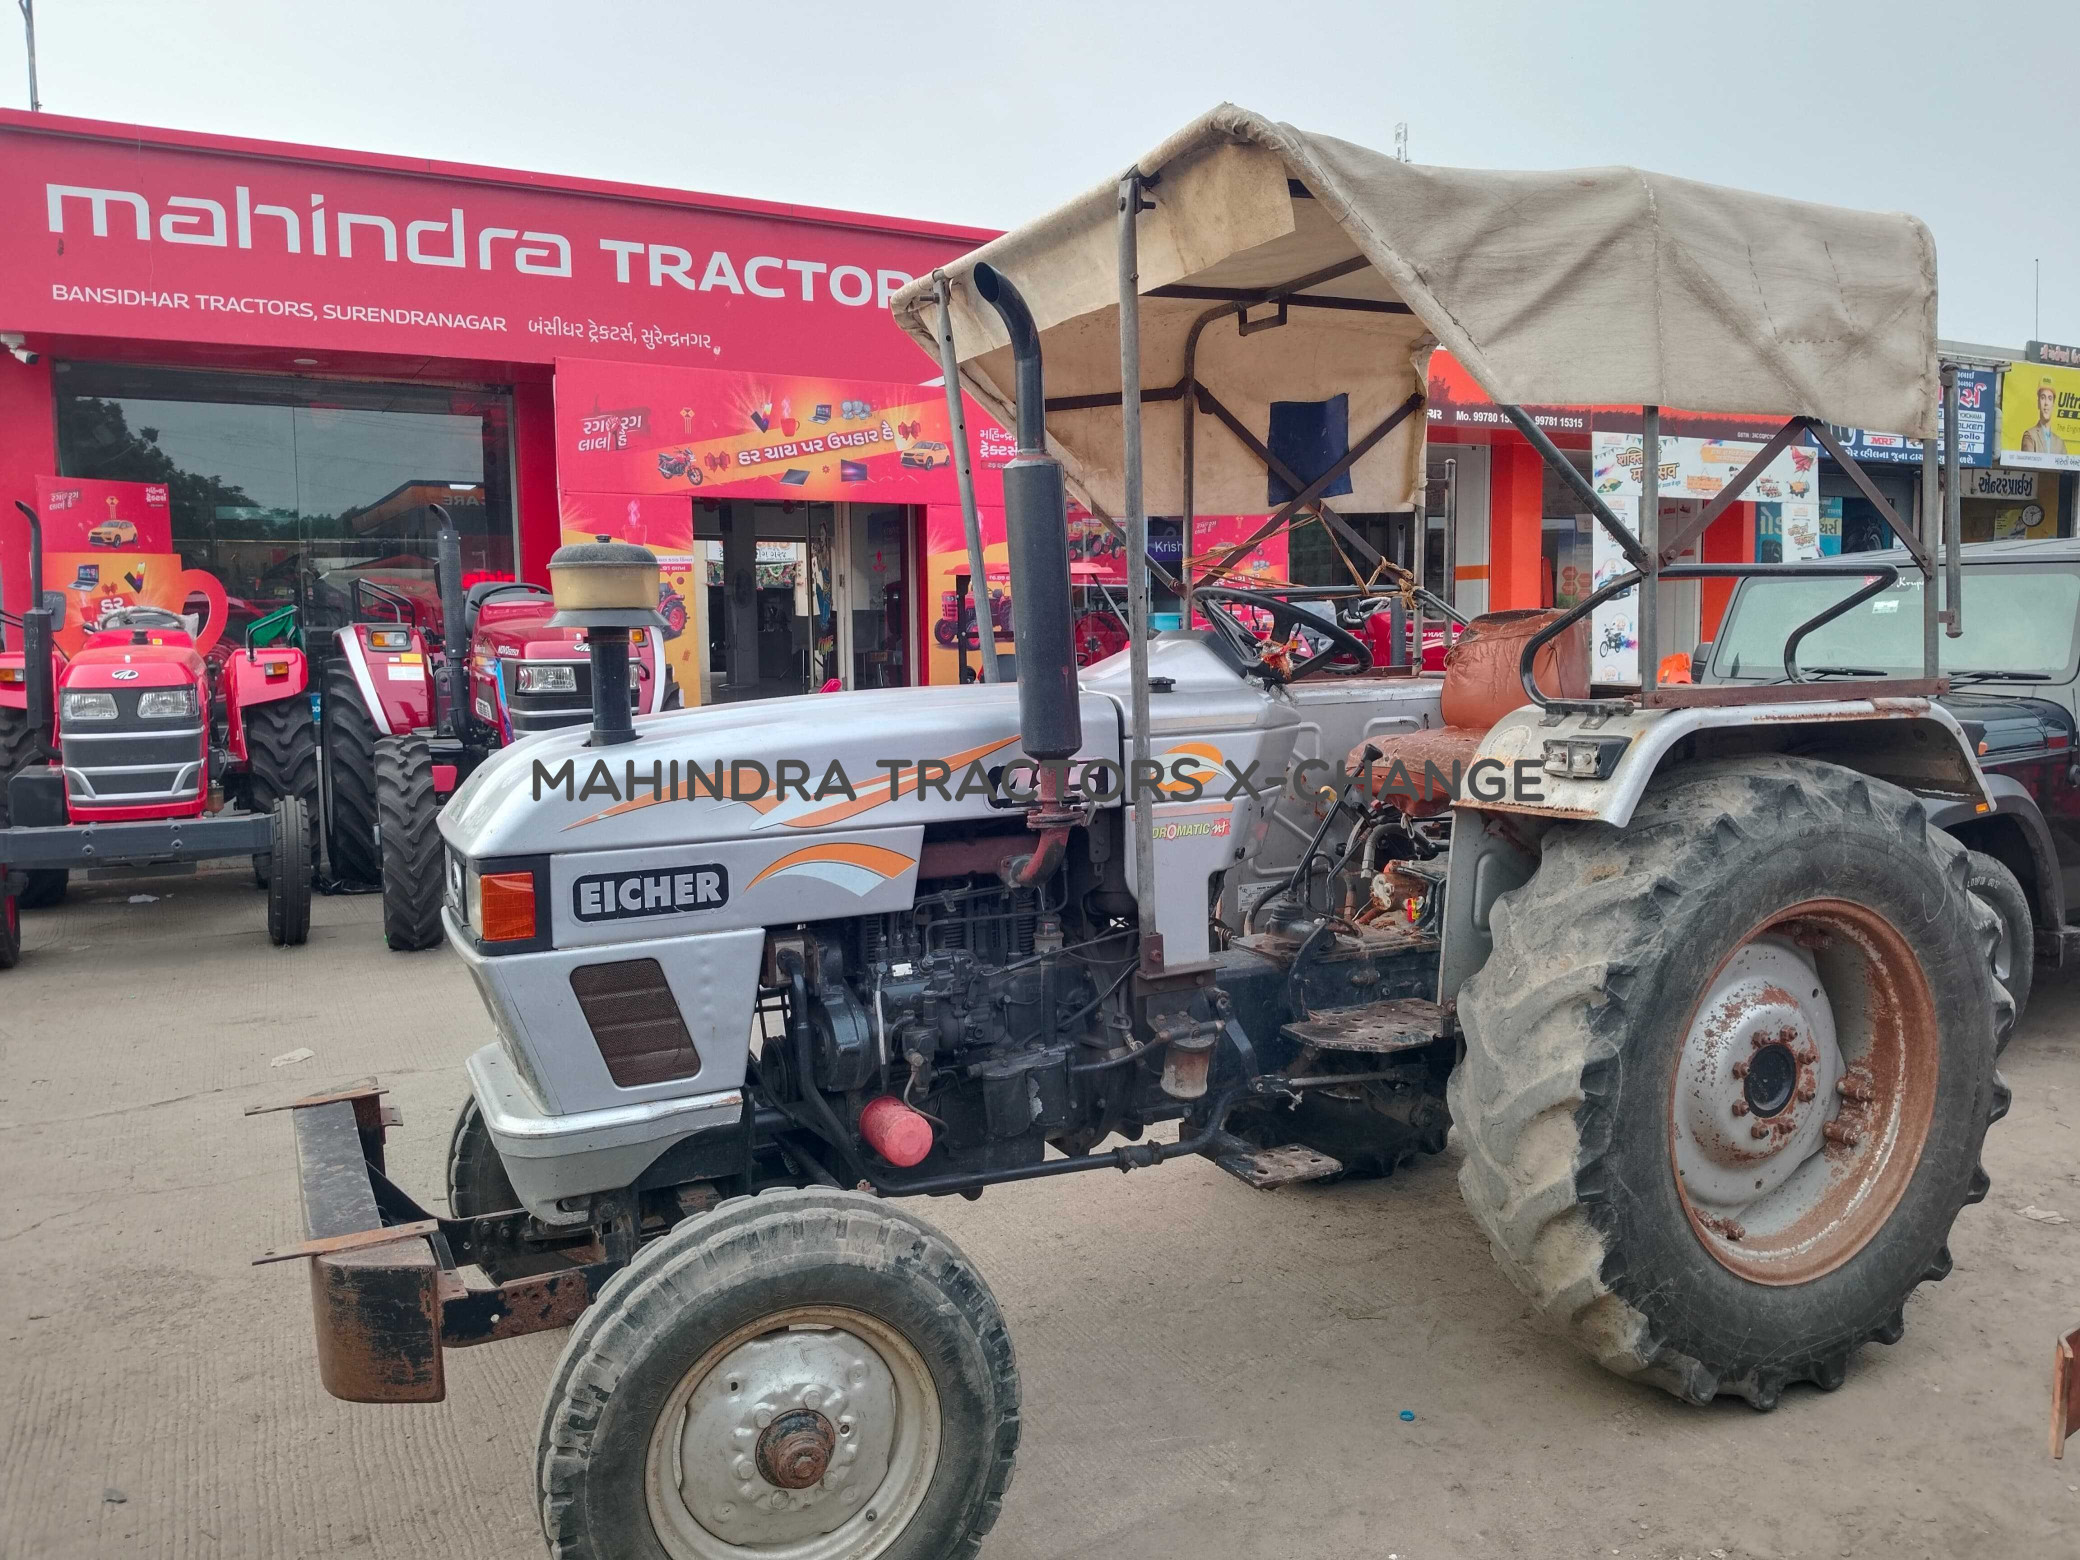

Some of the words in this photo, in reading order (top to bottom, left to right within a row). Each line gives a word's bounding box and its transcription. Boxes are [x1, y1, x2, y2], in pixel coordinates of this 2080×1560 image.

[46, 183, 573, 278] mahindra
[600, 239, 909, 310] TRACTOR
[52, 283, 190, 310] BANSIDHAR
[195, 293, 318, 321] TRACTORS,
[323, 303, 508, 333] SURENDRANAGAR
[528, 316, 584, 337] બંસીધર
[641, 325, 711, 350] સુરેન્દ્રનગર
[2058, 392, 2080, 409] Ultr
[1456, 411, 1471, 421] Mo.
[1473, 412, 1497, 423] 99780
[1535, 416, 1557, 426] 99781
[1560, 418, 1583, 428] 15315
[1959, 412, 1983, 420] OKOHAMA
[1871, 437, 1896, 445] MRF
[738, 450, 762, 466] હર
[764, 444, 799, 460] ચાય
[801, 439, 825, 453] પર
[1151, 822, 1211, 840] DROMATIC
[580, 870, 723, 915] EICHER
